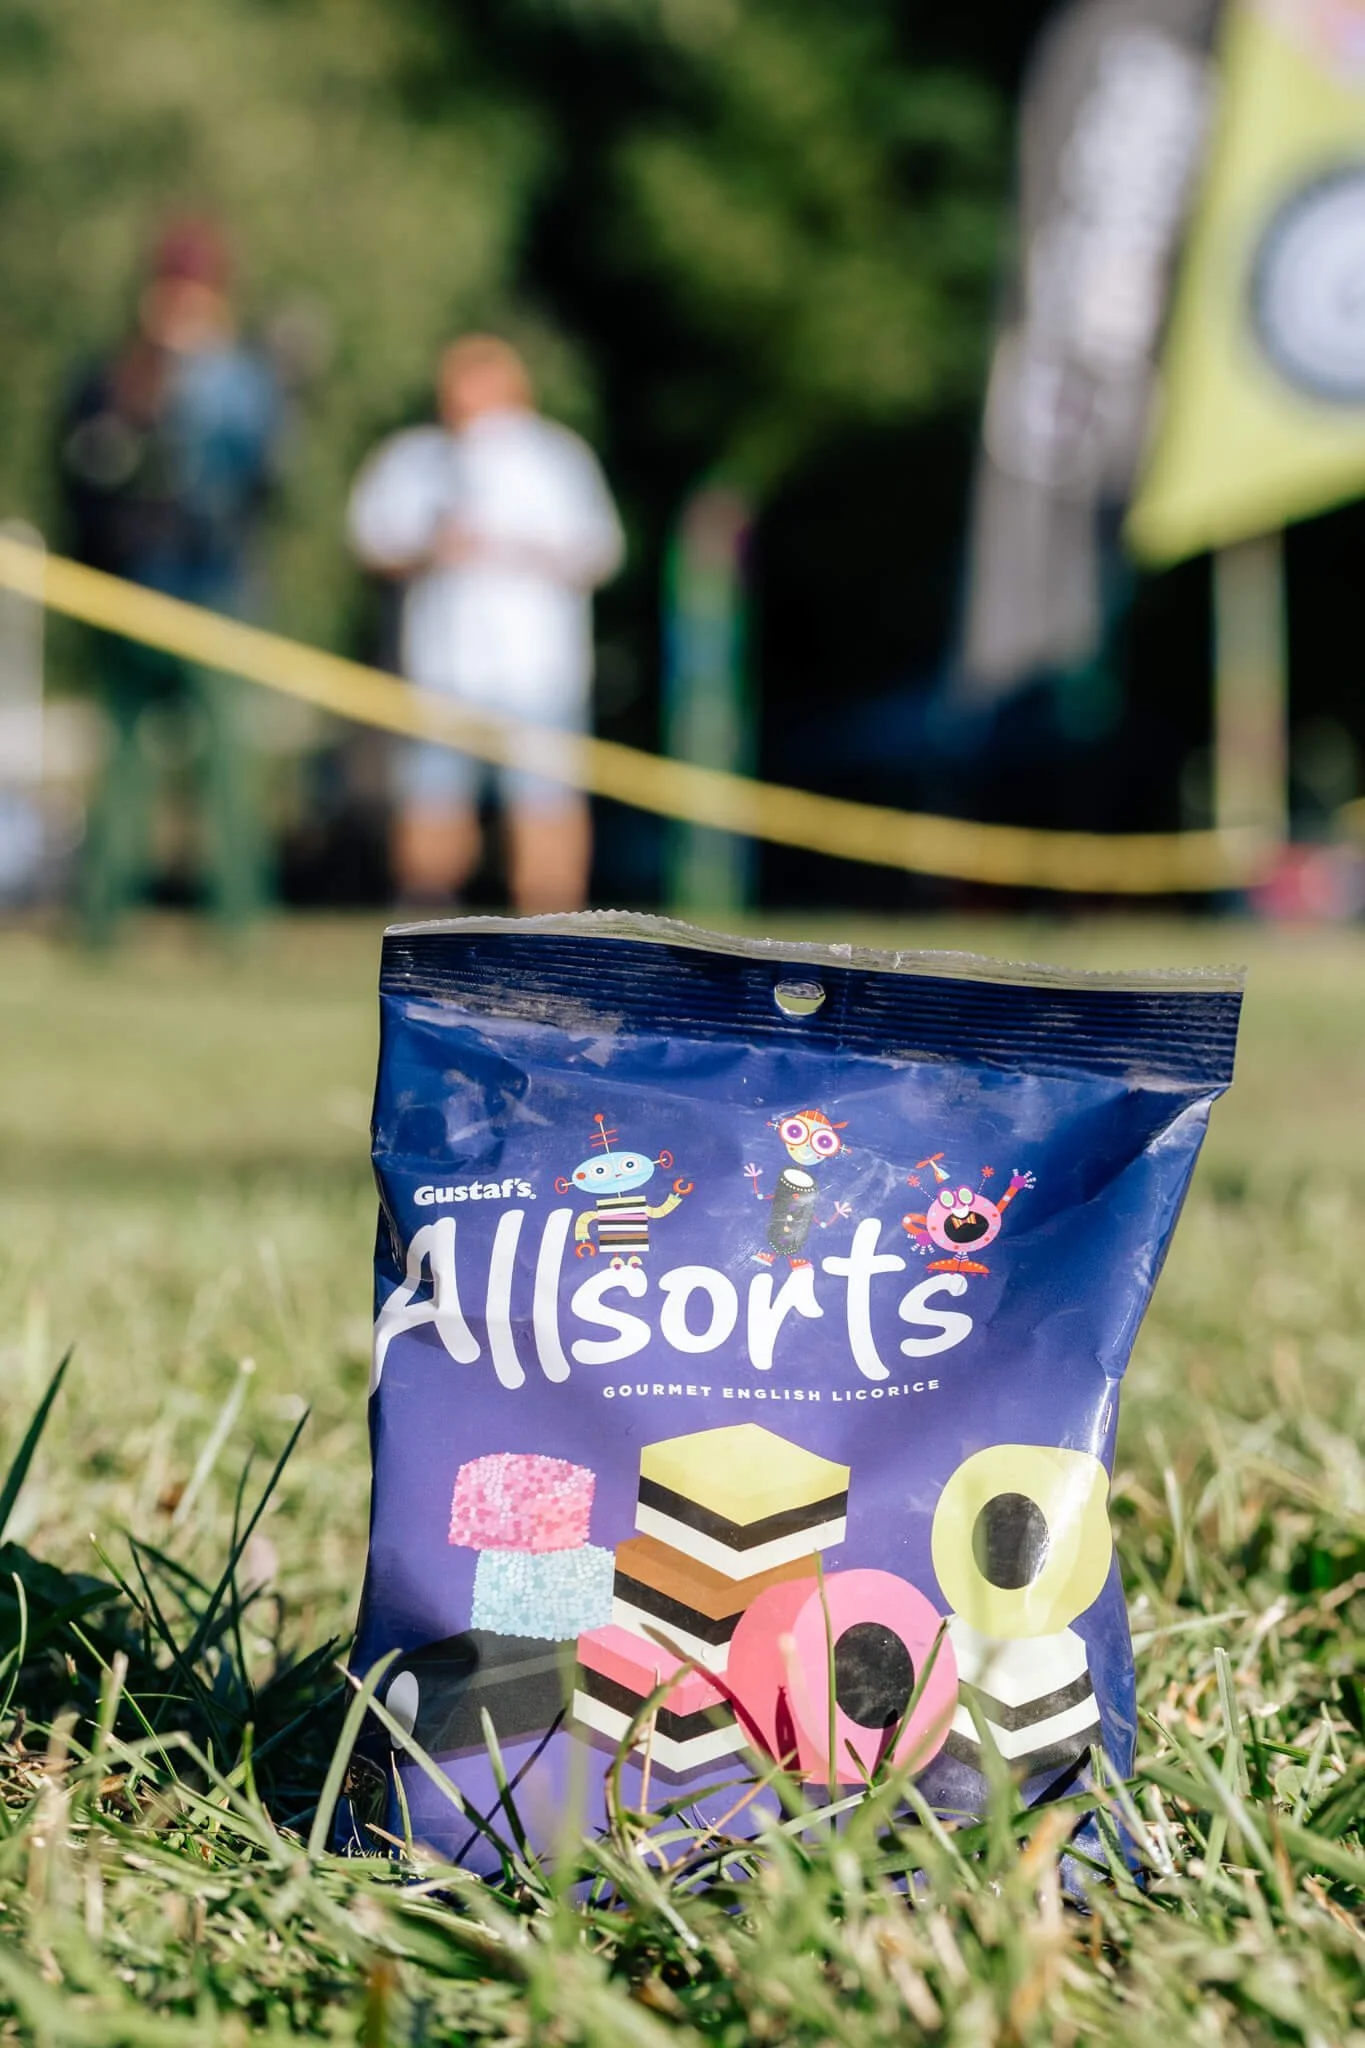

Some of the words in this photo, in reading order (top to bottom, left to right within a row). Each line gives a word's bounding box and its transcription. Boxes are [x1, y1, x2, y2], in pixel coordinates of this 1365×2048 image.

[369, 1208, 974, 1397] Allsorts
[602, 1383, 713, 1399] GOURMET
[722, 1387, 821, 1401] ENGLISH
[831, 1379, 940, 1401] LICORICE
